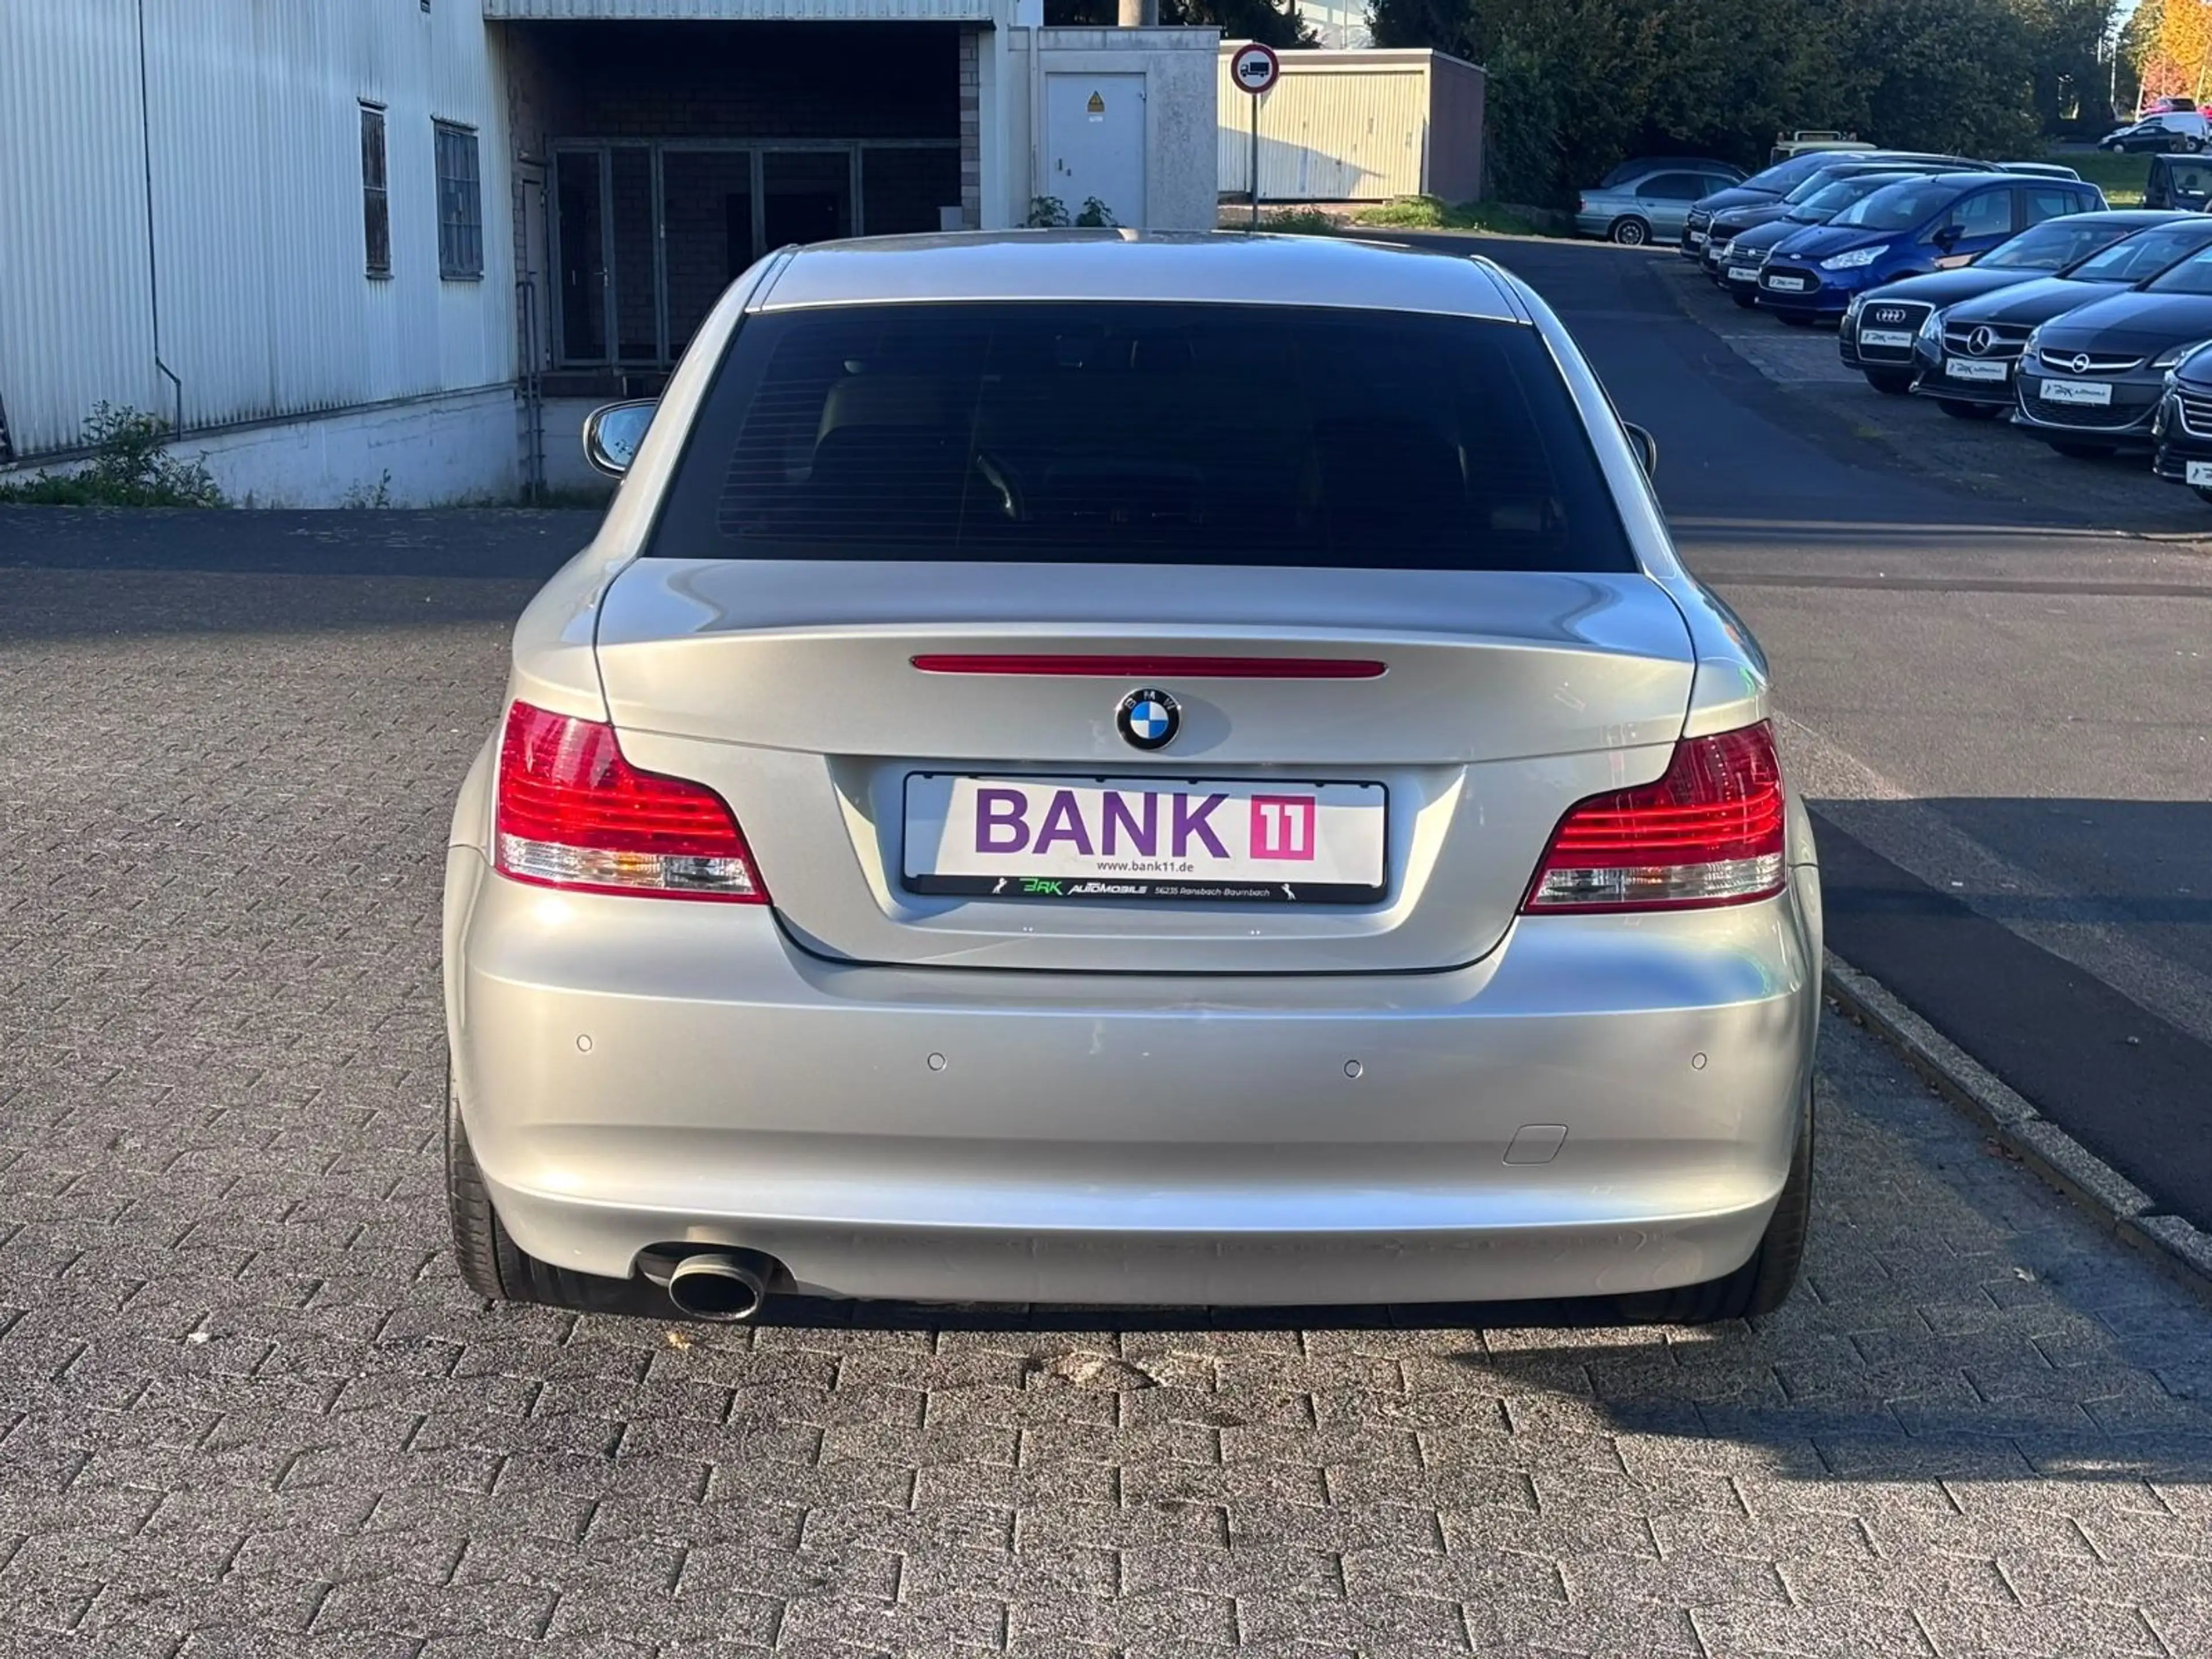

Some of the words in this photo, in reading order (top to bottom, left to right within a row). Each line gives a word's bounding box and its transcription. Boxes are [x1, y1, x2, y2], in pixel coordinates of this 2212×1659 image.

[1124, 691, 1176, 710] BMW
[976, 789, 1230, 858] BANK
[1260, 804, 1305, 852] 11
[1097, 860, 1194, 872] www.bank11.de
[1067, 881, 1148, 895] AUTOMOBILE
